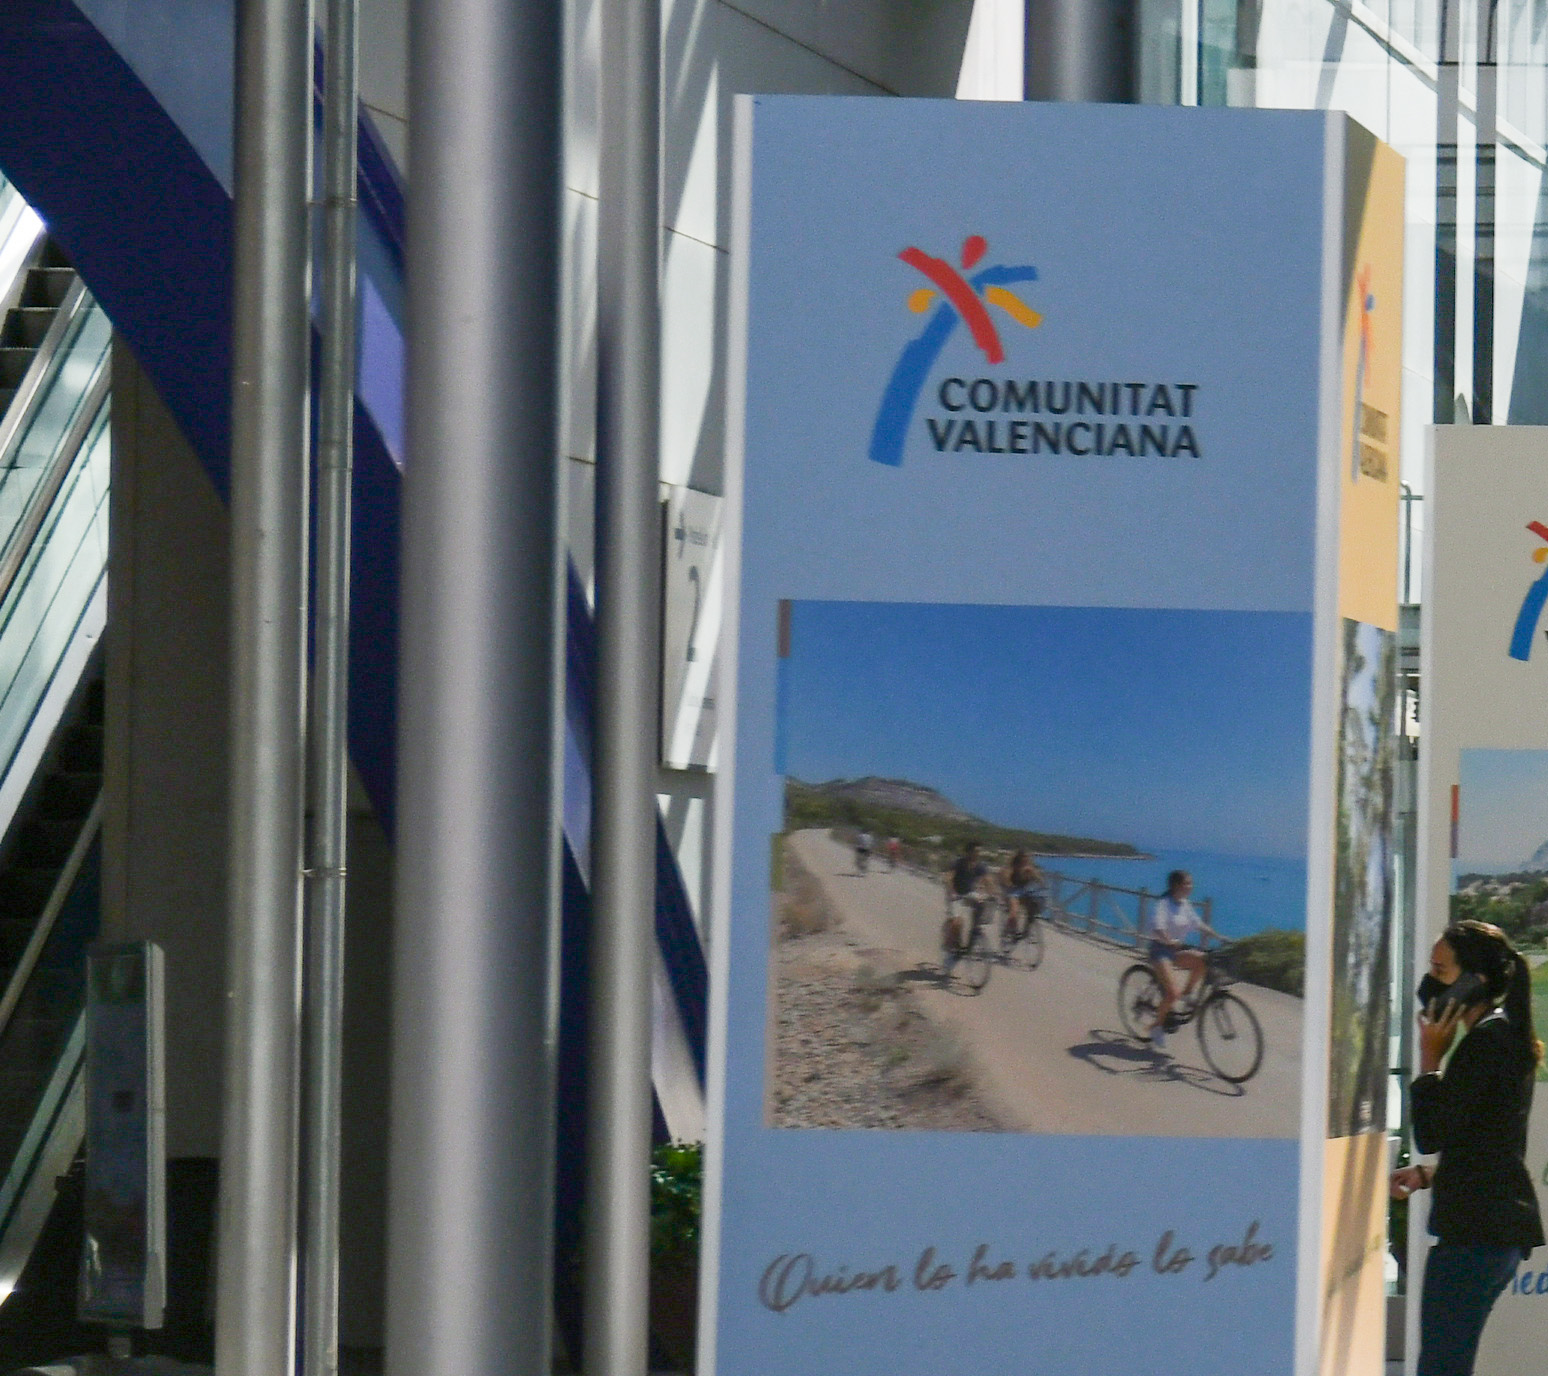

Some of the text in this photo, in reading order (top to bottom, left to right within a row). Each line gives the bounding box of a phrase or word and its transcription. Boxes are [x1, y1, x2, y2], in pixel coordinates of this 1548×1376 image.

[939, 377, 1199, 419] COMUNITAT
[926, 419, 1200, 458] VALENCIANA
[760, 1252, 901, 1313] Quien
[914, 1245, 958, 1292] lo
[967, 1243, 1016, 1287] ha
[1029, 1241, 1141, 1282] vivido
[1153, 1230, 1196, 1274] lo
[1205, 1220, 1274, 1282] sabe
